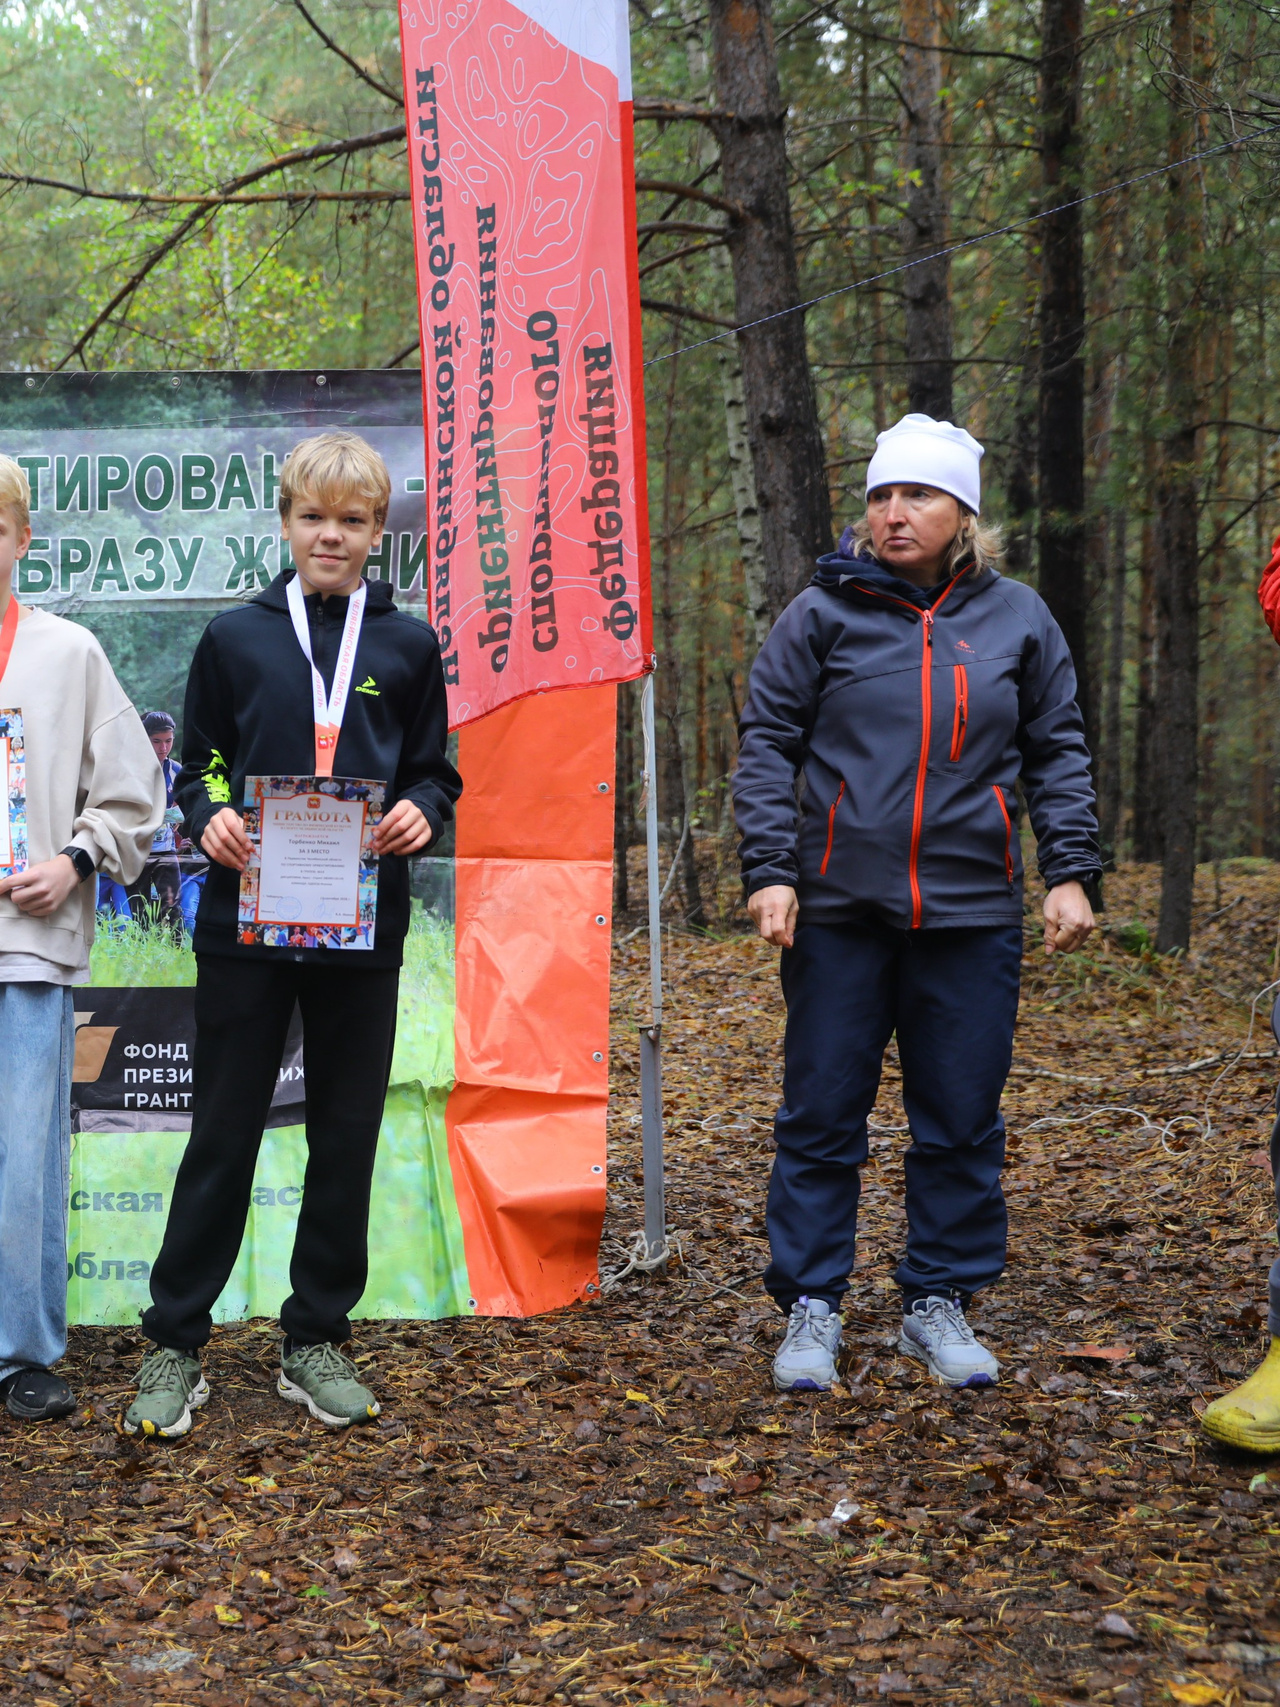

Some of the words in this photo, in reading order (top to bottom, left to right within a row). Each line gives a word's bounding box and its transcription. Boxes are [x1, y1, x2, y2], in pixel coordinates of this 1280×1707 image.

[19, 537, 203, 592] БРАЗУ
[341, 599, 361, 664] ЧЕЛЯБИНСКАЯ
[333, 664, 348, 707] ОБЛАСТЬ
[355, 686, 381, 697] DEMIX
[274, 810, 352, 823] ГРАМОТА
[123, 1043, 189, 1061] ФОНД
[123, 1092, 193, 1108] ГРАНТ
